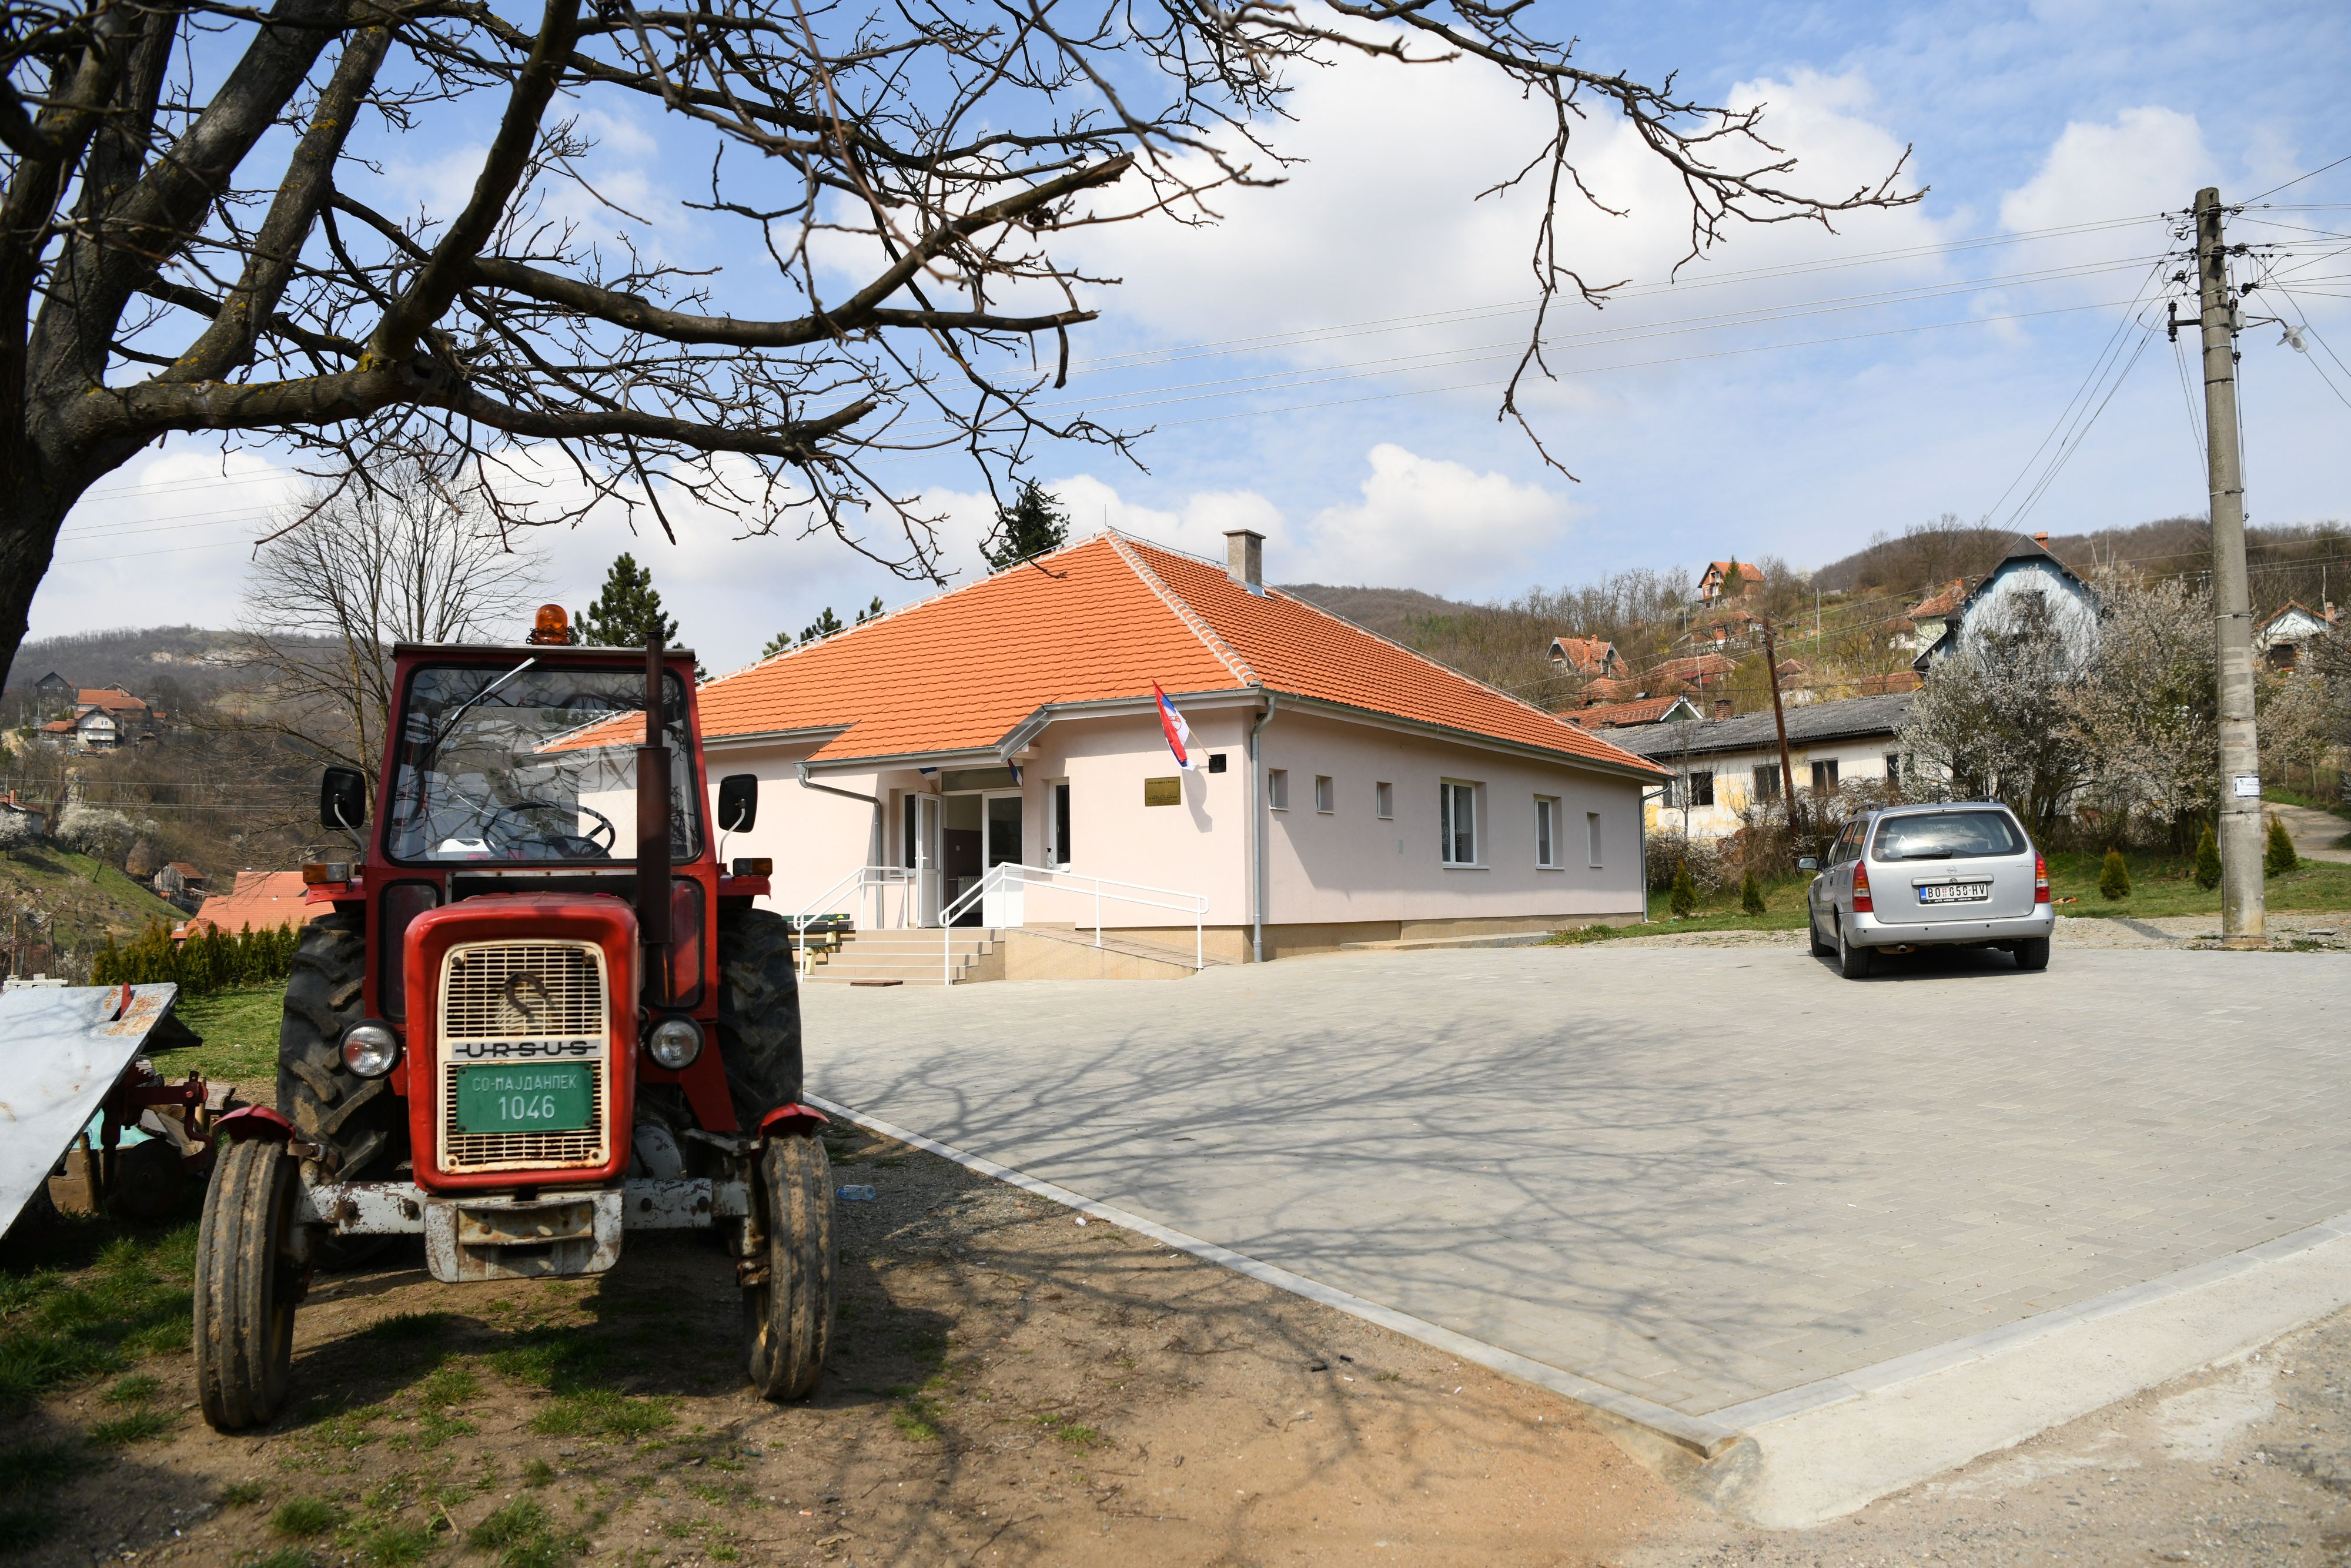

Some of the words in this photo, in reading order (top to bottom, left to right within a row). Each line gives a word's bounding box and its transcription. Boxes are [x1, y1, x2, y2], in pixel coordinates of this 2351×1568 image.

[1928, 887, 1941, 898] BO
[466, 1041, 588, 1058] URSUS
[499, 1095, 556, 1121] 1046
